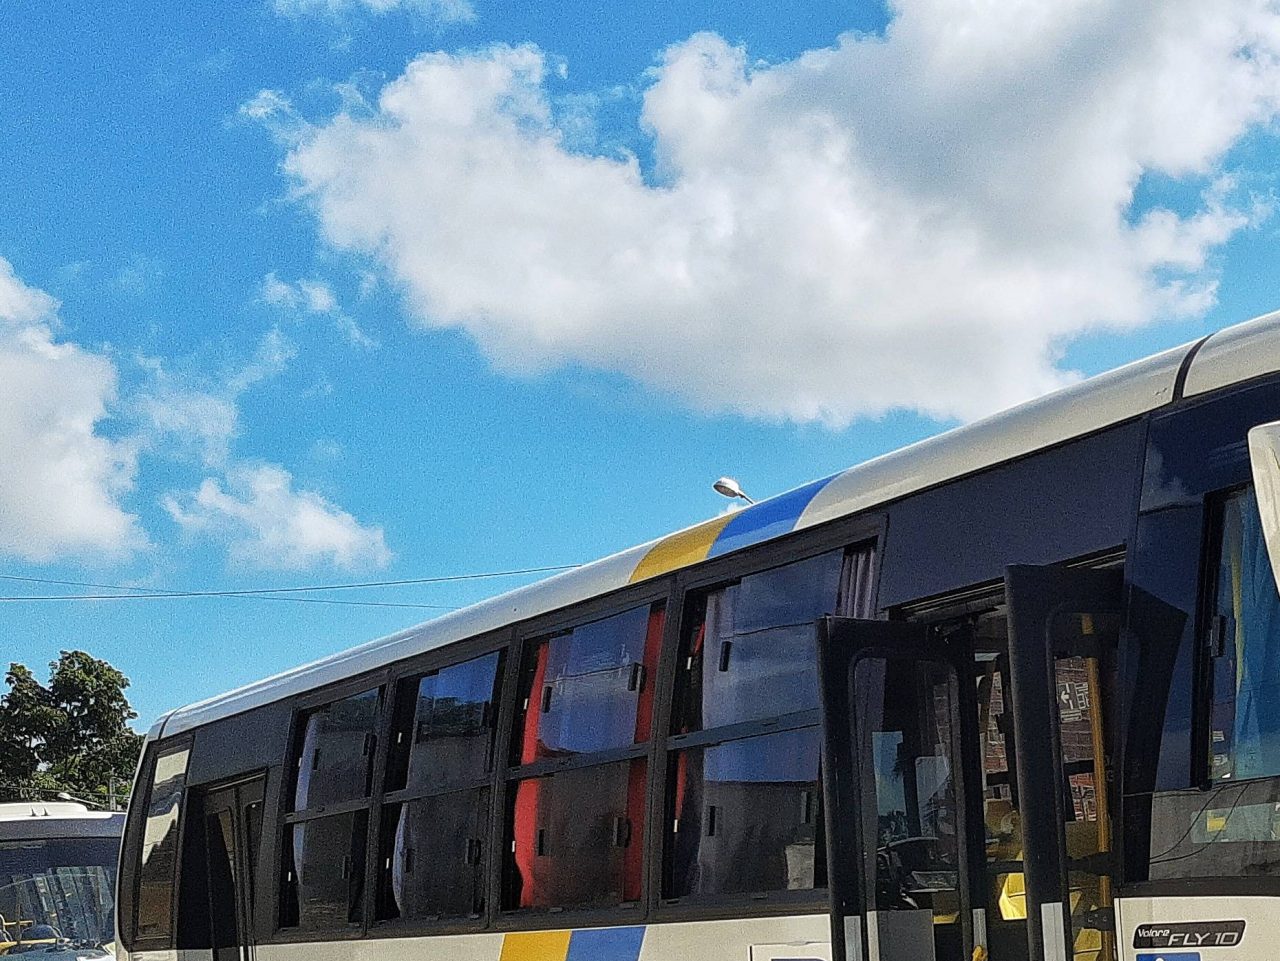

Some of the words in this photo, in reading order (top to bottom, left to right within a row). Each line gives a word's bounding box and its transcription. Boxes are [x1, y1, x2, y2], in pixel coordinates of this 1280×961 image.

[1137, 928, 1171, 938] Volare
[1167, 932, 1211, 946] FLY
[1214, 931, 1239, 945] 10
